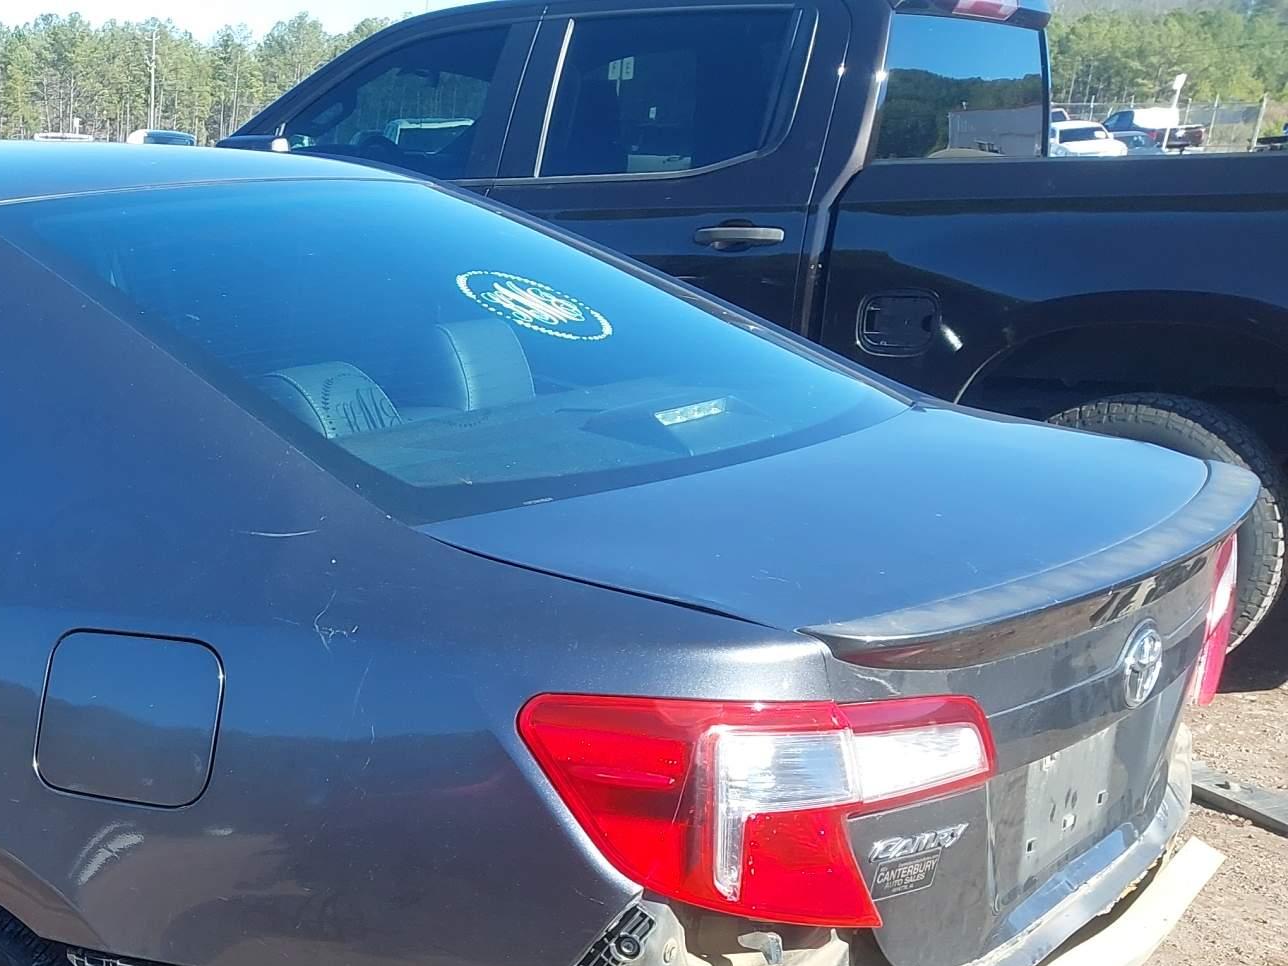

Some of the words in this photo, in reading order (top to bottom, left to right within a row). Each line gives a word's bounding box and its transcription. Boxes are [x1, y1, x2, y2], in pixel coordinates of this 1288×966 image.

[869, 822, 969, 863] CAMRY
[876, 858, 938, 884] CANTERBURY
[884, 879, 904, 890] AUTO
[903, 872, 926, 885] SALES
